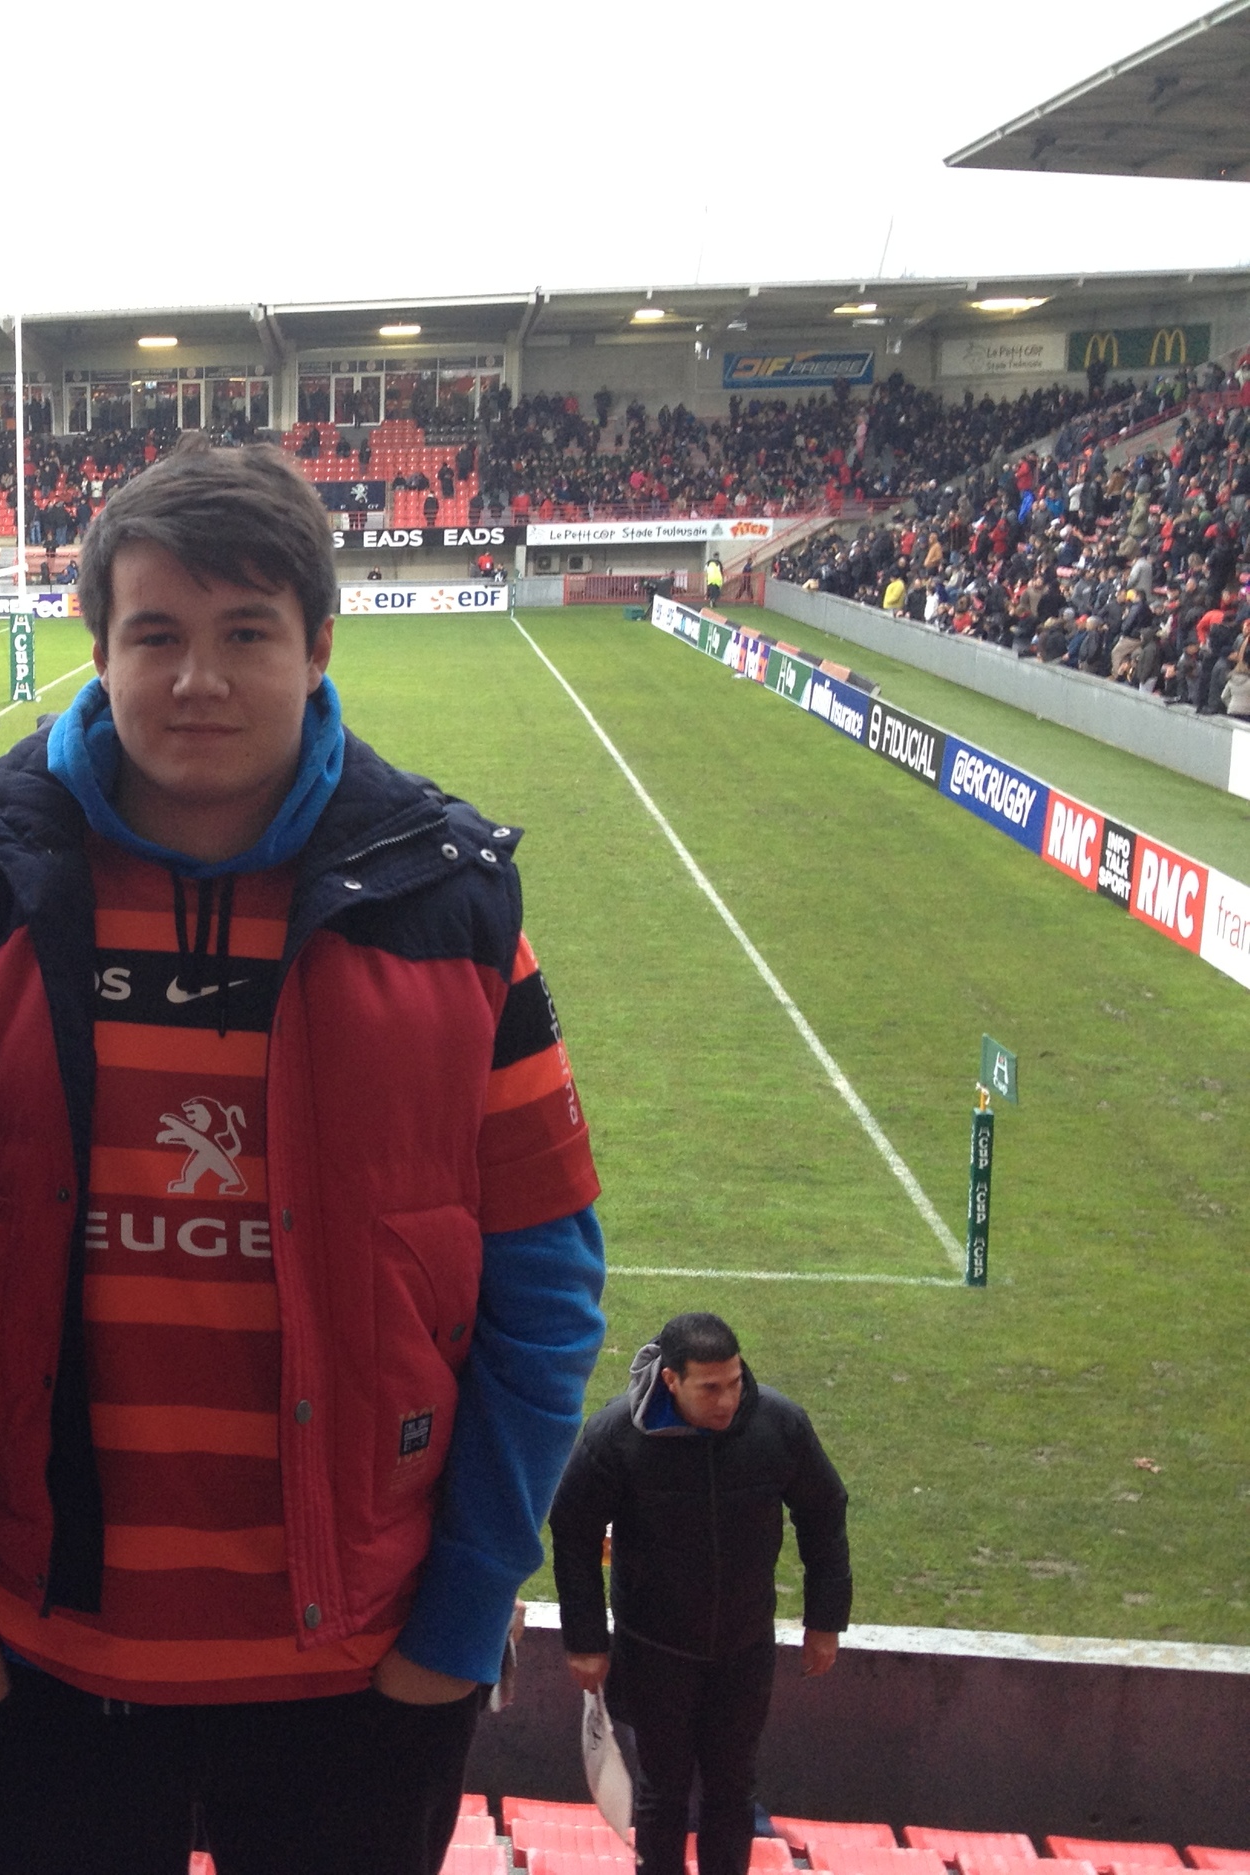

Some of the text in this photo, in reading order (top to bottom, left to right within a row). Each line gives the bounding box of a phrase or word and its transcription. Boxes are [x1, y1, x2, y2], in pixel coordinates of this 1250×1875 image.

[363, 528, 505, 548] EADS EADS
[549, 530, 562, 540] Le
[564, 529, 591, 542] Petit
[622, 527, 653, 541] Stade
[656, 525, 707, 538] Toulousain
[882, 715, 936, 781] FIDUCIAL
[950, 749, 1037, 828] @ERCRUGBY
[1047, 801, 1097, 878] RMC
[1107, 831, 1130, 859] INFO
[1098, 866, 1131, 901] SPORT
[1105, 849, 1129, 880] TALK
[1136, 848, 1200, 938] RMC
[1216, 895, 1250, 955] fran
[85, 1212, 271, 1258] EUGE
